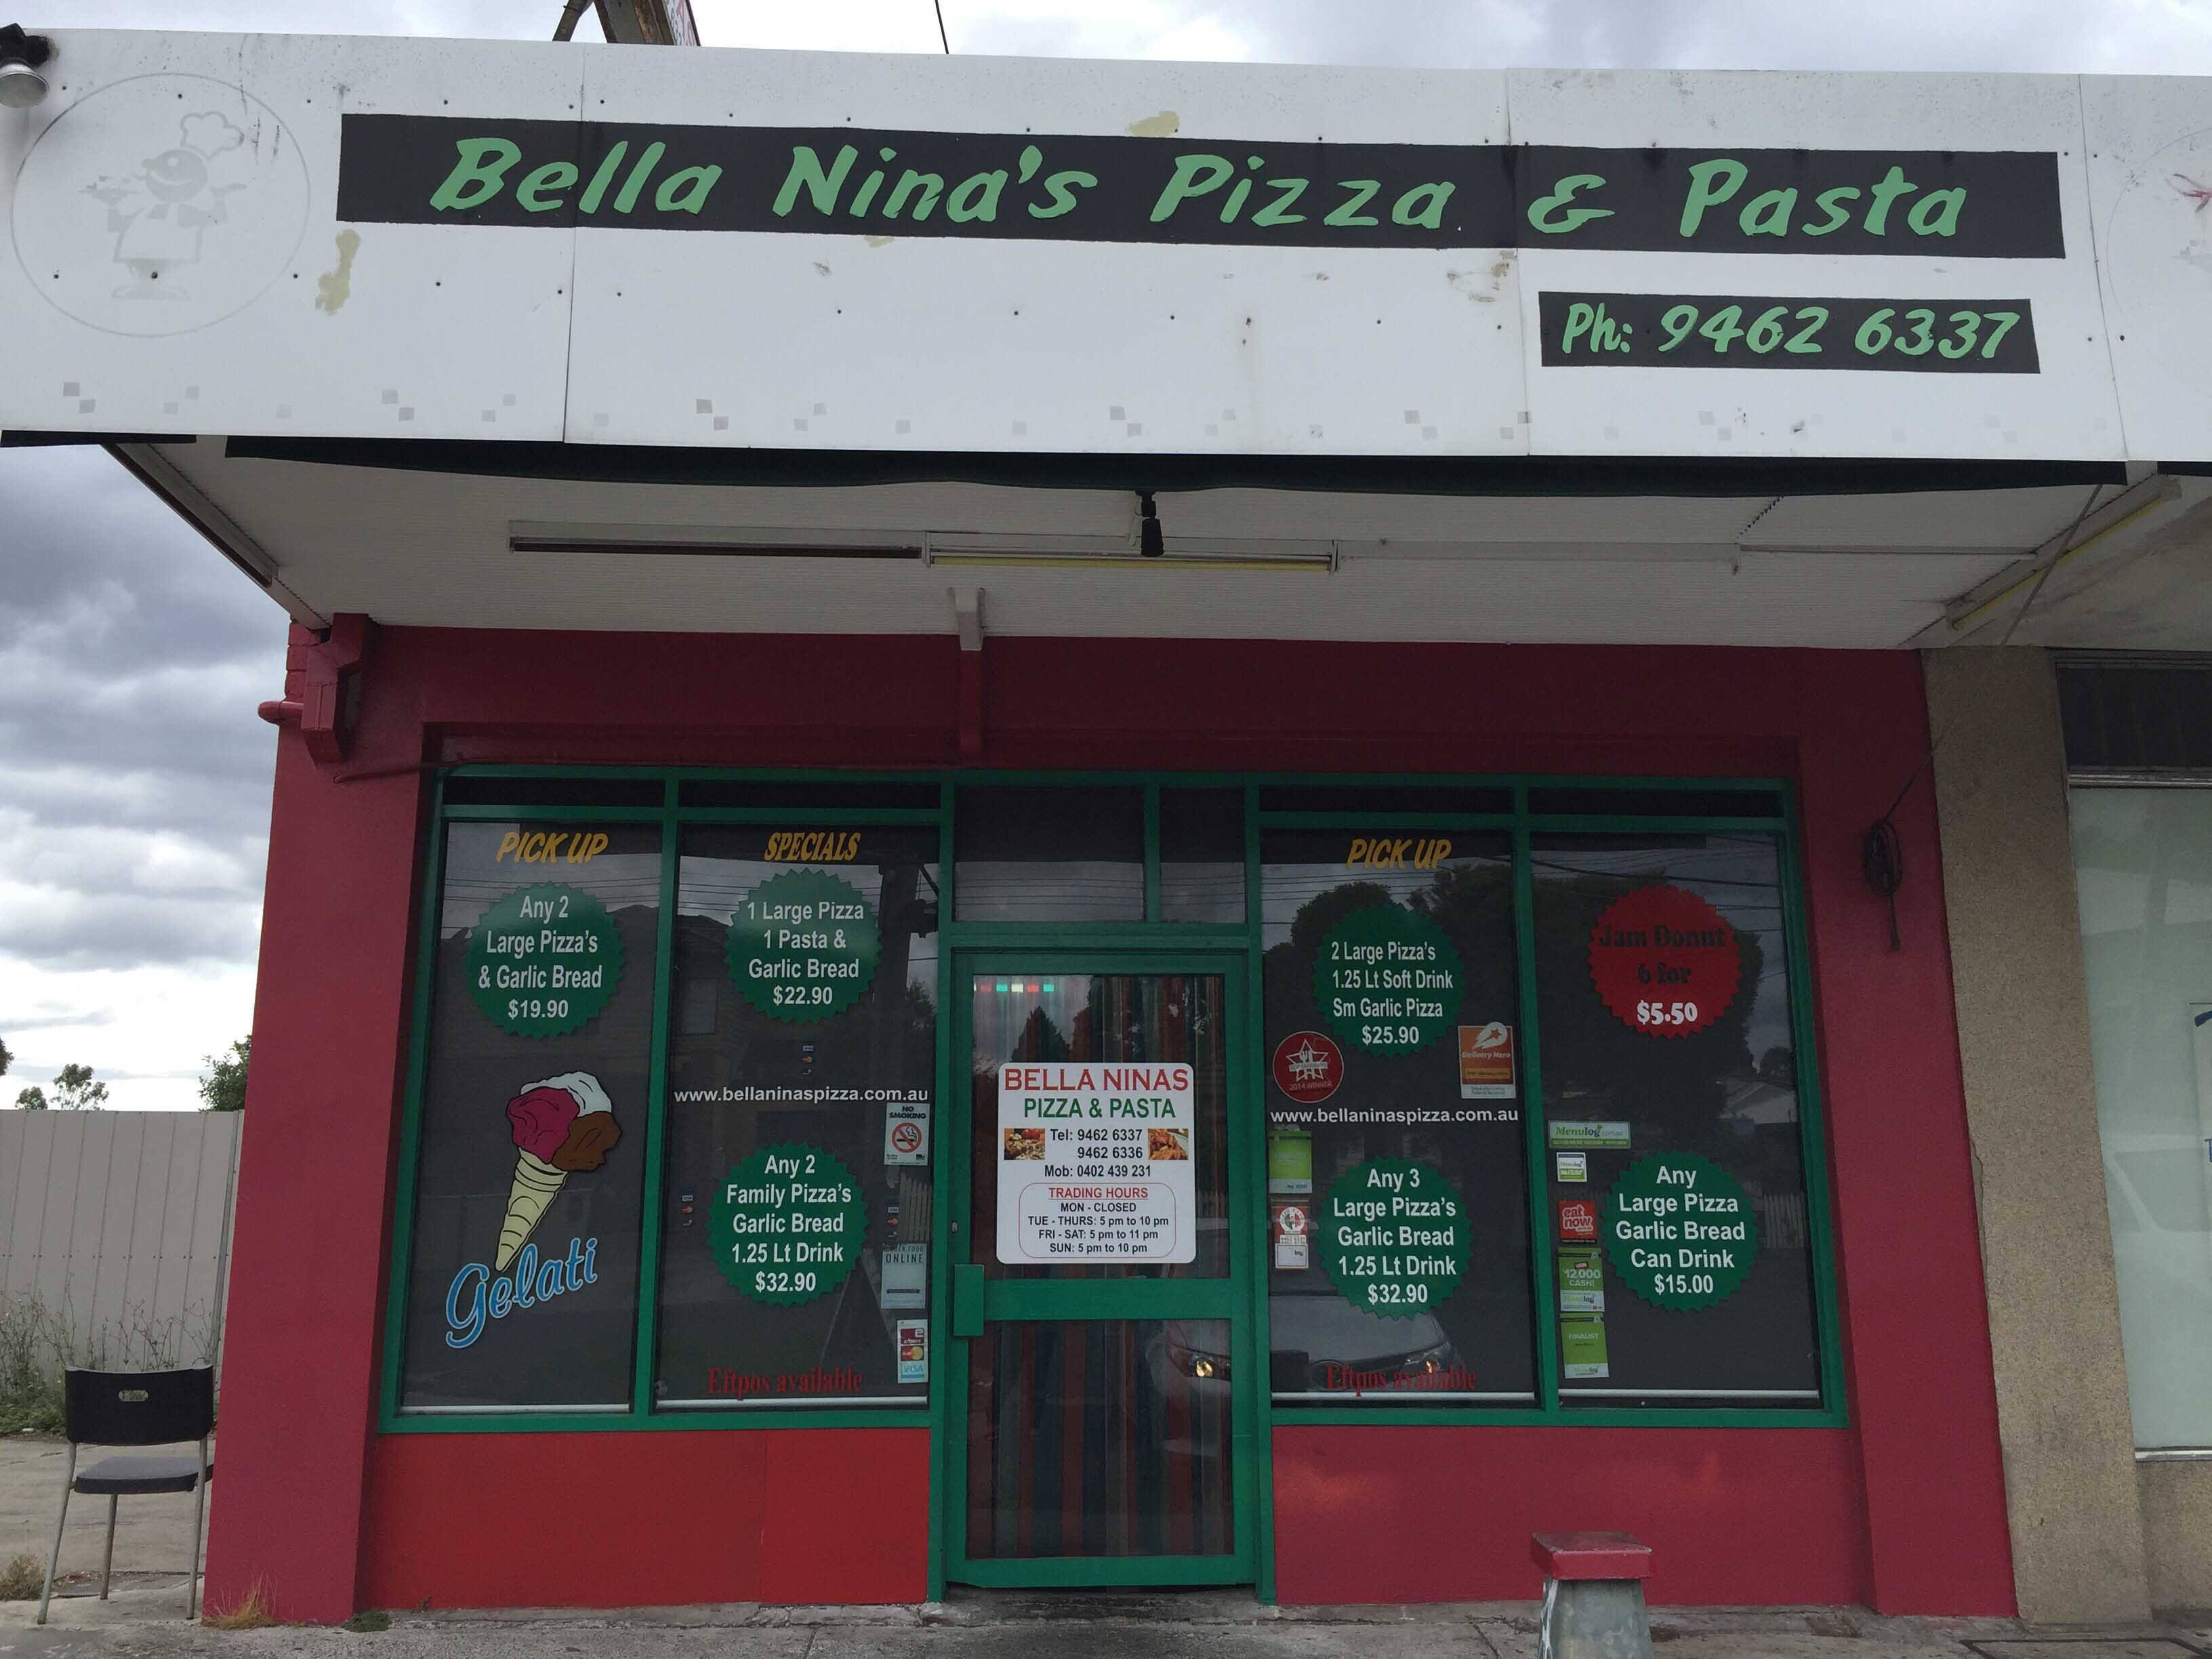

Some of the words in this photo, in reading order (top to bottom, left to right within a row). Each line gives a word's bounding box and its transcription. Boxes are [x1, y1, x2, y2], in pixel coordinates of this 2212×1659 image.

[430, 136, 722, 215] Bella
[773, 144, 1098, 223] Nina's
[1149, 155, 1456, 231] Pizza
[1528, 174, 1615, 234] &
[1680, 158, 1968, 237] Pasta
[1561, 302, 1633, 354] Ph:
[1658, 304, 1829, 354] 9462
[1854, 308, 2020, 360] 6337
[495, 832, 568, 863] PICK
[567, 833, 609, 864] UP
[764, 832, 861, 861] SPECIALS
[1346, 838, 1413, 869] PICK
[1413, 839, 1452, 869] UP
[520, 895, 554, 924] Any
[558, 895, 569, 918] 2
[747, 902, 756, 920] 1
[762, 902, 813, 924] Large
[818, 901, 864, 920] Pizza
[487, 930, 535, 959] Large
[540, 930, 598, 954] Pizza's
[764, 930, 772, 949] 1
[779, 930, 827, 949] Pasta
[834, 929, 846, 949] &
[1599, 924, 1647, 947] Jam
[1653, 924, 1726, 948] Donut
[1331, 941, 1339, 960] 2
[1344, 941, 1383, 965] Large
[1388, 941, 1436, 961] Pizza's
[478, 965, 491, 989] &
[497, 965, 547, 989] Garlic
[552, 964, 602, 989] Bread
[748, 958, 802, 978] Garlic
[807, 958, 859, 978] Bread
[1656, 962, 1692, 985] for
[1332, 970, 1361, 989] 1.25
[1365, 970, 1380, 989] Lt
[1382, 969, 1412, 989] Soft
[1416, 969, 1454, 989] Drink
[773, 985, 833, 1006] $22.90
[508, 999, 569, 1020] $19.90
[1333, 998, 1355, 1017] Sm
[1360, 998, 1402, 1017] Garlic
[1406, 998, 1443, 1017] Pizza
[1637, 1000, 1698, 1025] $5.50
[1361, 1025, 1420, 1046] $25.90
[1004, 1068, 1096, 1091] BELLA
[1103, 1068, 1189, 1091] NINAS
[674, 1086, 928, 1103] www.bellaninaspizza.com.au
[1024, 1098, 1083, 1118] PIZZA
[1088, 1098, 1103, 1118] &
[1109, 1098, 1176, 1118] PASTA
[1270, 1108, 1519, 1125] www.bellaninaspizza.com.au
[1050, 1128, 1073, 1141] Tel:
[1078, 1129, 1108, 1141] 9462
[1112, 1129, 1143, 1141] 6337
[1556, 1127, 1600, 1138] Menulog
[1078, 1147, 1108, 1159] 9462
[1112, 1147, 1143, 1159] 6336
[764, 1154, 800, 1179] Any
[805, 1154, 815, 1174] 2
[1044, 1164, 1073, 1177] Mob:
[1077, 1165, 1105, 1177] 0402
[1108, 1165, 1128, 1177] 439
[1132, 1165, 1151, 1177] 231
[1366, 1168, 1404, 1193] Any
[1410, 1168, 1420, 1188] 3
[1656, 1166, 1697, 1189] Any
[726, 1184, 786, 1209] Family
[791, 1183, 852, 1204] Pizza's
[1048, 1187, 1103, 1198] TRADING
[1105, 1187, 1149, 1198] HOURS
[1060, 1202, 1085, 1212] MON
[1093, 1202, 1136, 1212] CLOSED
[1334, 1197, 1387, 1222] Large
[1392, 1197, 1456, 1216] Pizza's
[1564, 1206, 1583, 1218] eat
[1618, 1193, 1678, 1217] Large
[1684, 1193, 1739, 1212] Pizza
[733, 1213, 786, 1233] Garlic
[791, 1212, 844, 1233] Bread
[1028, 1216, 1049, 1226] TUE
[1058, 1216, 1097, 1226] THURS:
[1099, 1216, 1105, 1225] 5
[1108, 1218, 1124, 1228] pm
[1126, 1216, 1137, 1226] to
[1139, 1216, 1151, 1225] 10
[1153, 1218, 1169, 1228] pm
[1564, 1217, 1591, 1227] now
[1616, 1221, 1678, 1240] Garlic
[1684, 1221, 1746, 1240] Bread
[1039, 1230, 1055, 1239] FRI
[1064, 1229, 1086, 1240] SAT:
[1089, 1230, 1096, 1239] 5
[1098, 1231, 1114, 1242] pm
[1116, 1230, 1127, 1240] to
[1129, 1230, 1140, 1239] 11
[1143, 1231, 1159, 1242] pm
[1338, 1226, 1393, 1246] Garlic
[1399, 1226, 1454, 1246] Bread
[732, 1243, 768, 1263] 1.25
[773, 1243, 791, 1263] Lt
[796, 1242, 844, 1262] Drink
[886, 1253, 923, 1264] ONLINE
[1050, 1243, 1076, 1253] SUN:
[1078, 1243, 1084, 1253] 5
[1086, 1246, 1103, 1255] pm
[1105, 1244, 1116, 1253] to
[1118, 1243, 1129, 1253] 10
[1132, 1246, 1148, 1255] pm
[1631, 1248, 1673, 1268] Can
[1678, 1248, 1735, 1269] Drink
[1338, 1255, 1376, 1276] 1.25
[1382, 1256, 1401, 1275] Lt
[1406, 1255, 1457, 1275] Drink
[445, 1237, 598, 1348] Gelati
[755, 1271, 817, 1293] $32.90
[1654, 1274, 1714, 1295] $15.00
[1368, 1284, 1428, 1305] $32.90
[707, 1366, 771, 1401] Eftpos
[776, 1366, 863, 1393] available
[1326, 1364, 1388, 1397] Eftpos
[1393, 1364, 1477, 1389] available
